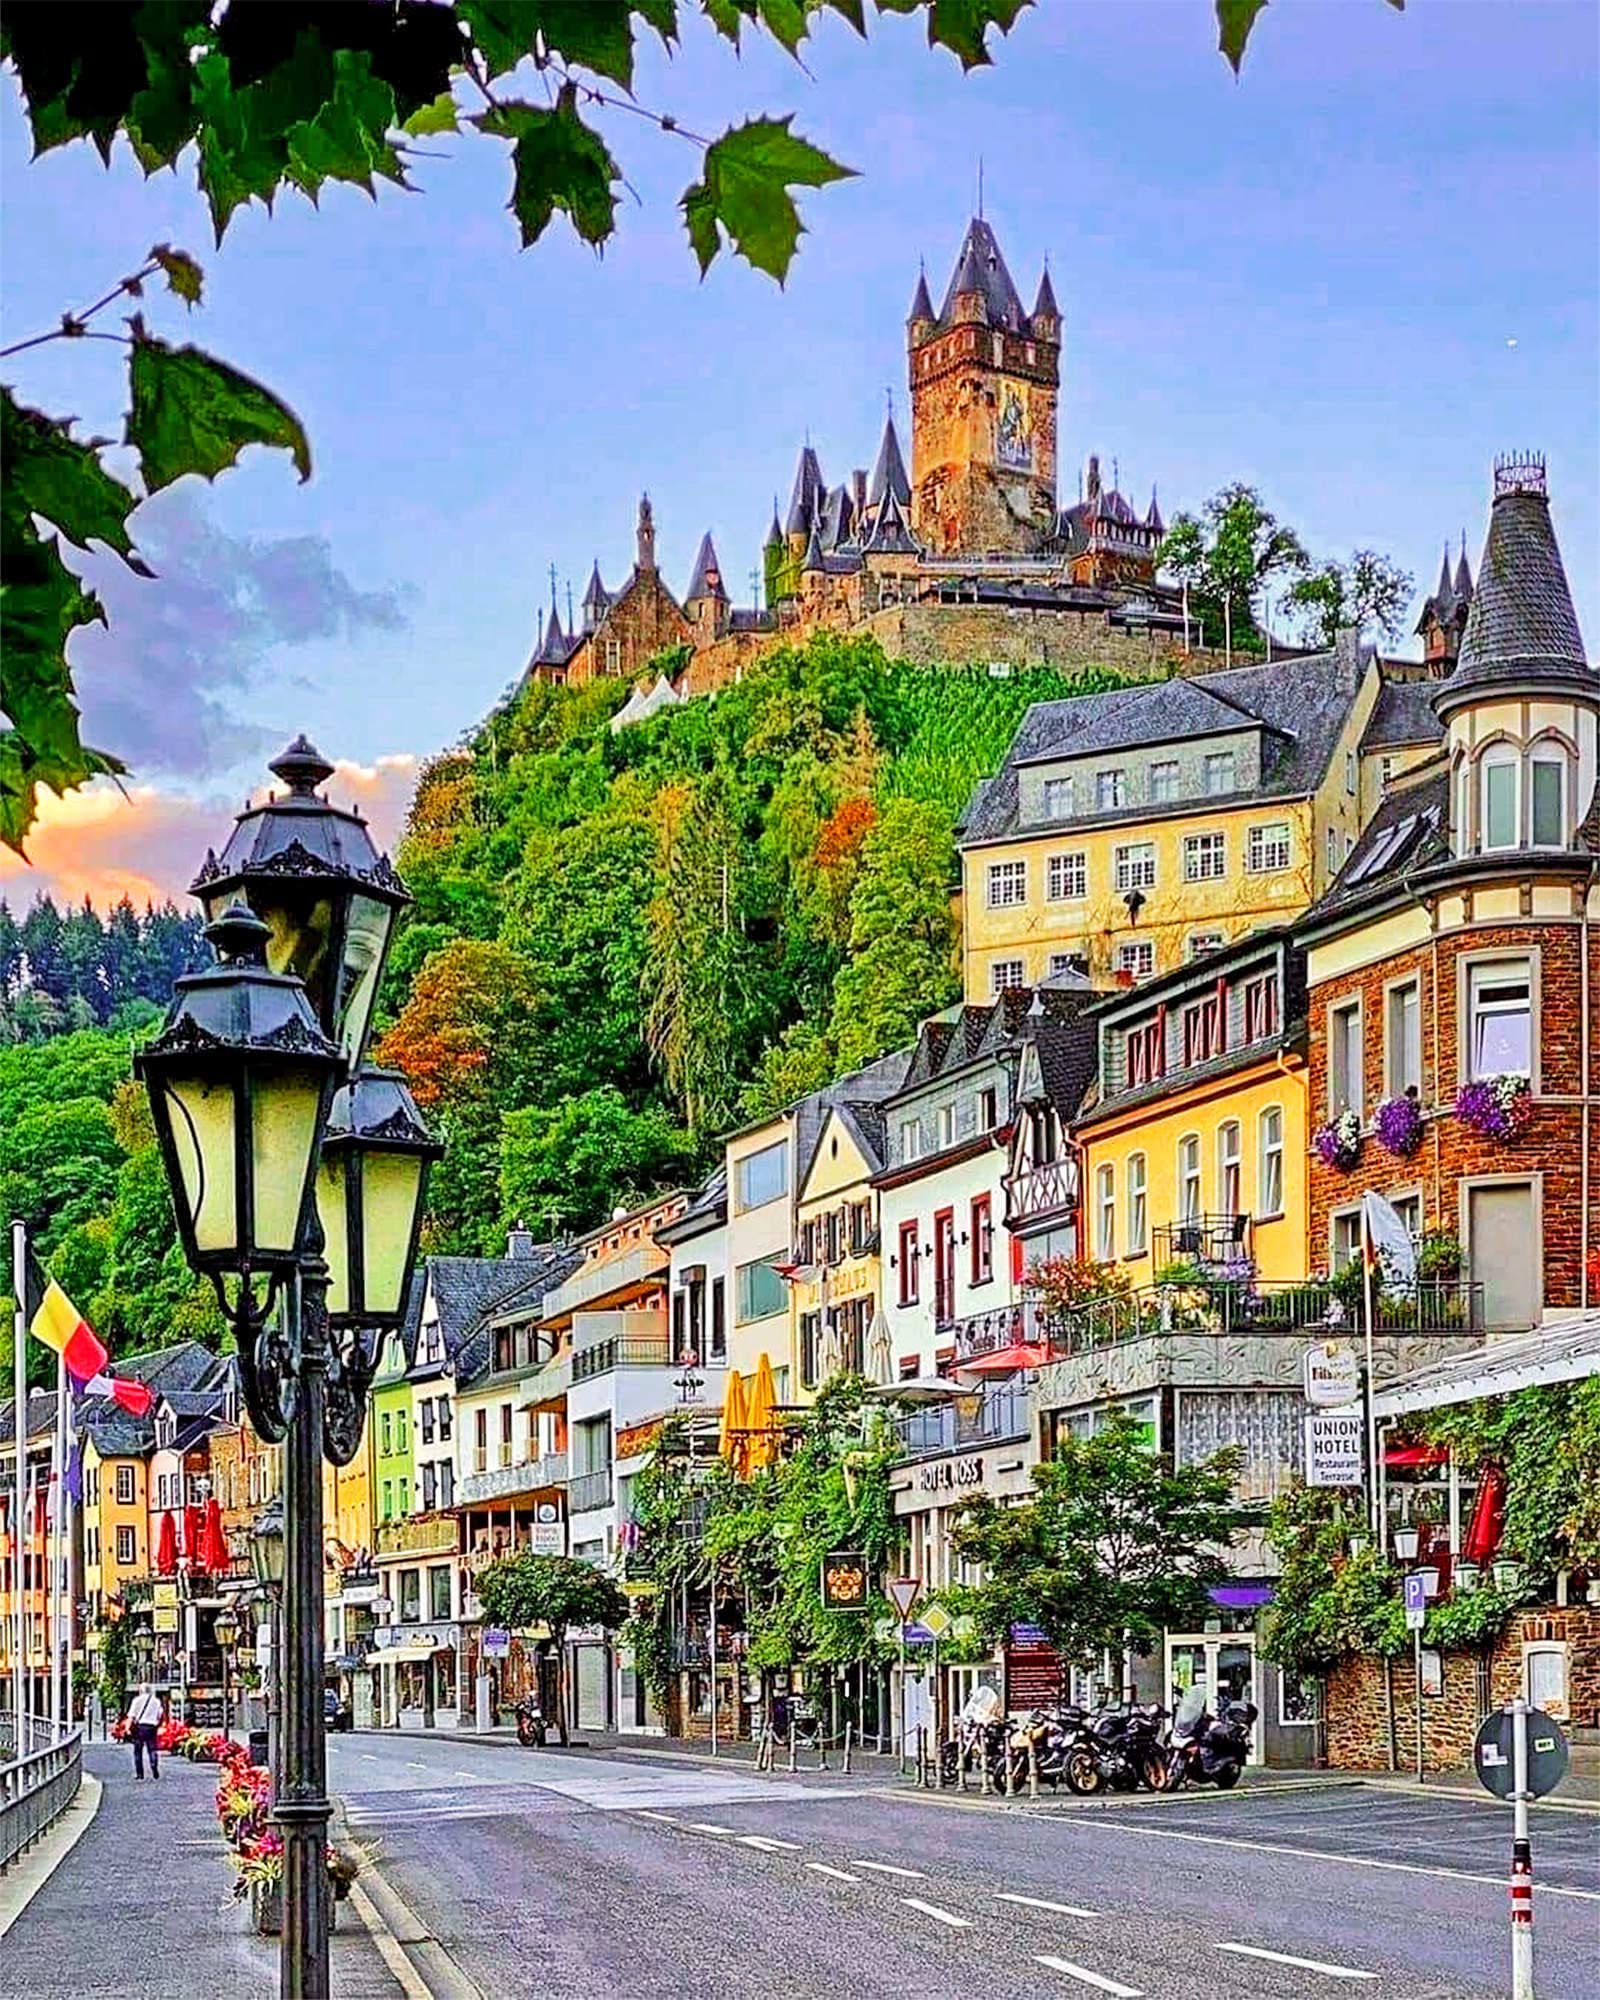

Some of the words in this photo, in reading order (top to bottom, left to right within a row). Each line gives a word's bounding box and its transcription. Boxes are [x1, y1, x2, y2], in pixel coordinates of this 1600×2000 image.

[1313, 1421, 1358, 1436] UNION
[1314, 1439, 1358, 1454] HOTEL
[1314, 1459, 1359, 1469] Restaurant
[919, 1464, 950, 1491] HOTEL
[1320, 1470, 1355, 1481] Terrasse
[1409, 1581, 1419, 1605] P
